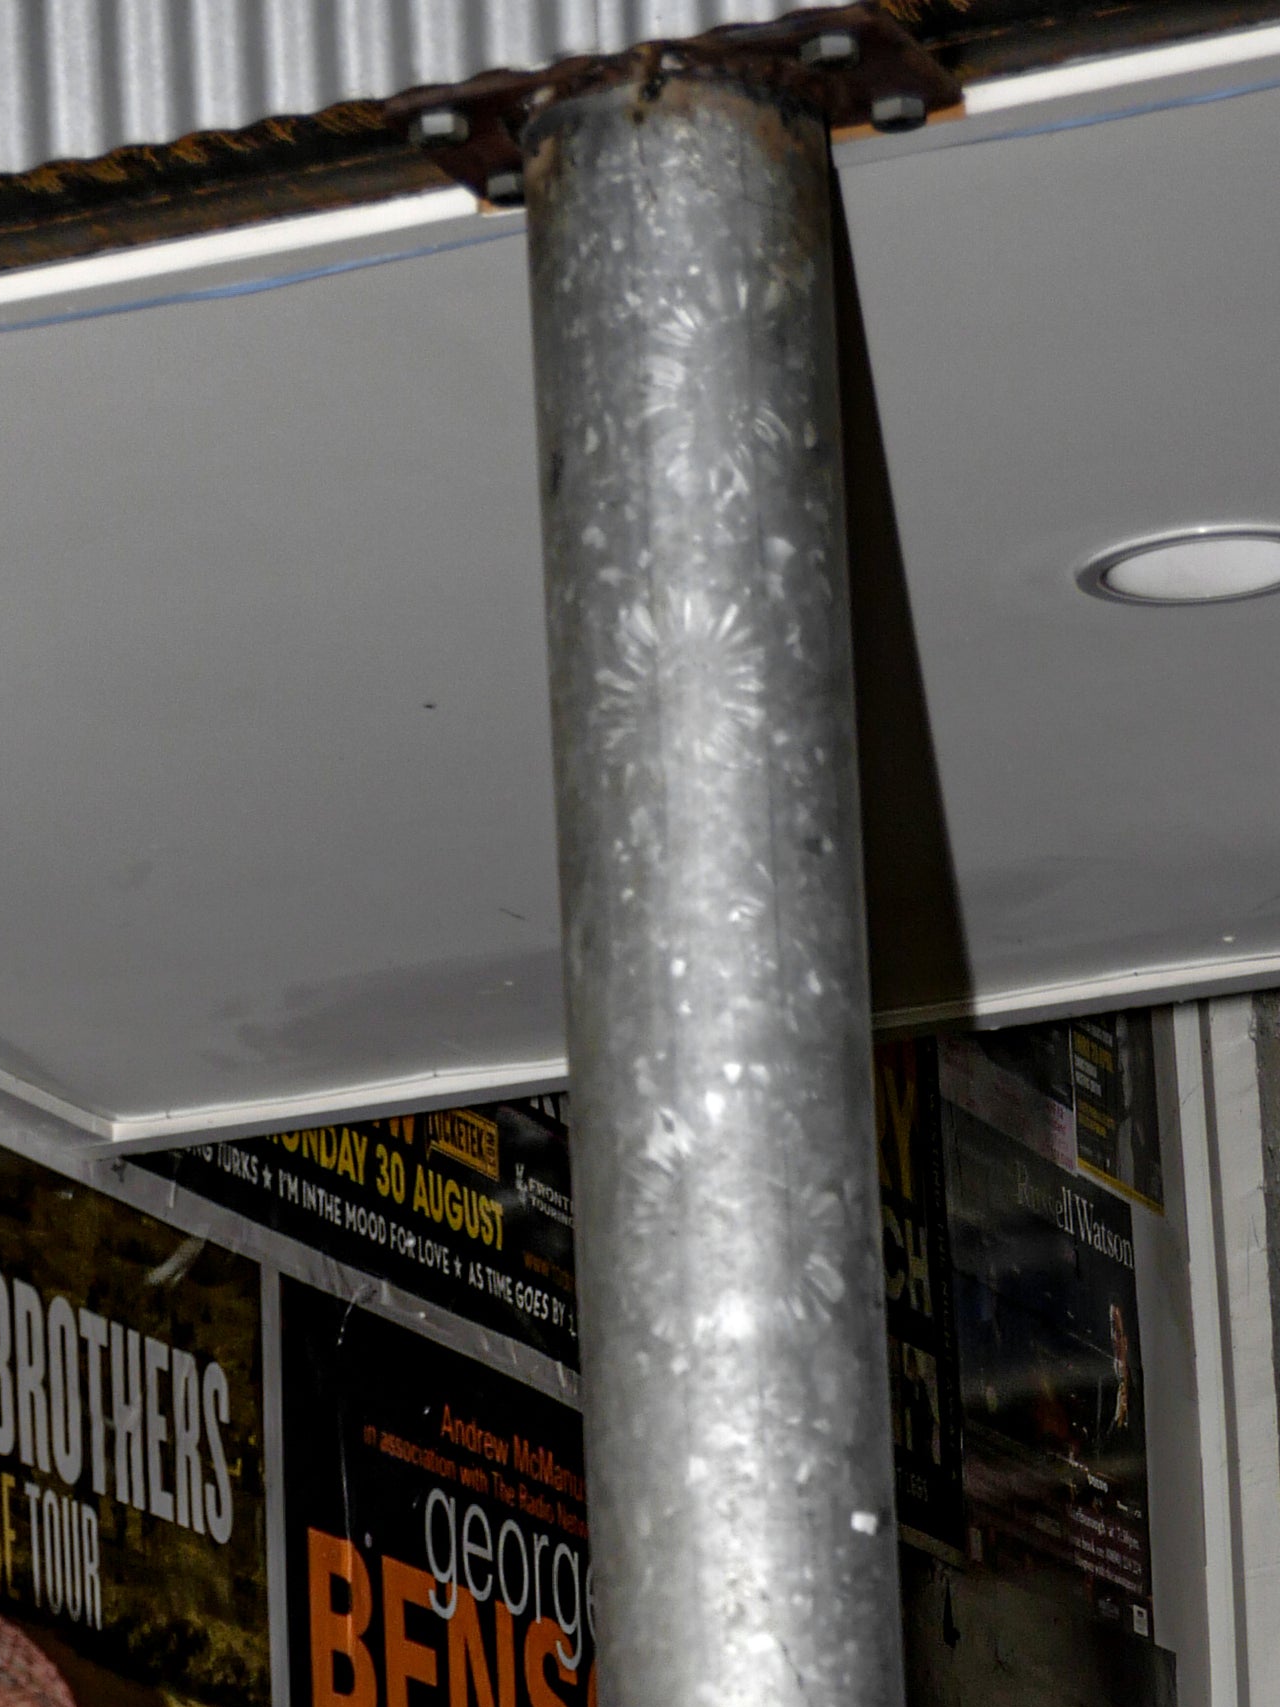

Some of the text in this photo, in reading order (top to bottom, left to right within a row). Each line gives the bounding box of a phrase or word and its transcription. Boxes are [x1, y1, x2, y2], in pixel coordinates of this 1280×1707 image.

[217, 1143, 259, 1185] TURKS
[278, 1168, 300, 1205] I'M
[345, 1200, 387, 1246] MOOD
[389, 1222, 416, 1260] FOR
[417, 1232, 451, 1277] LOVE
[468, 1261, 485, 1292] AS
[486, 1268, 514, 1304] TIME
[514, 1279, 546, 1321] GOES
[547, 1296, 566, 1329] BY
[266, 1126, 505, 1252] ONDAY 30 AUGUST
[1076, 1198, 1136, 1270] Watson
[379, 1431, 458, 1482] association
[440, 1402, 510, 1467] Andrew
[24, 1480, 104, 1632] TOUR
[424, 1487, 596, 1672] georg
